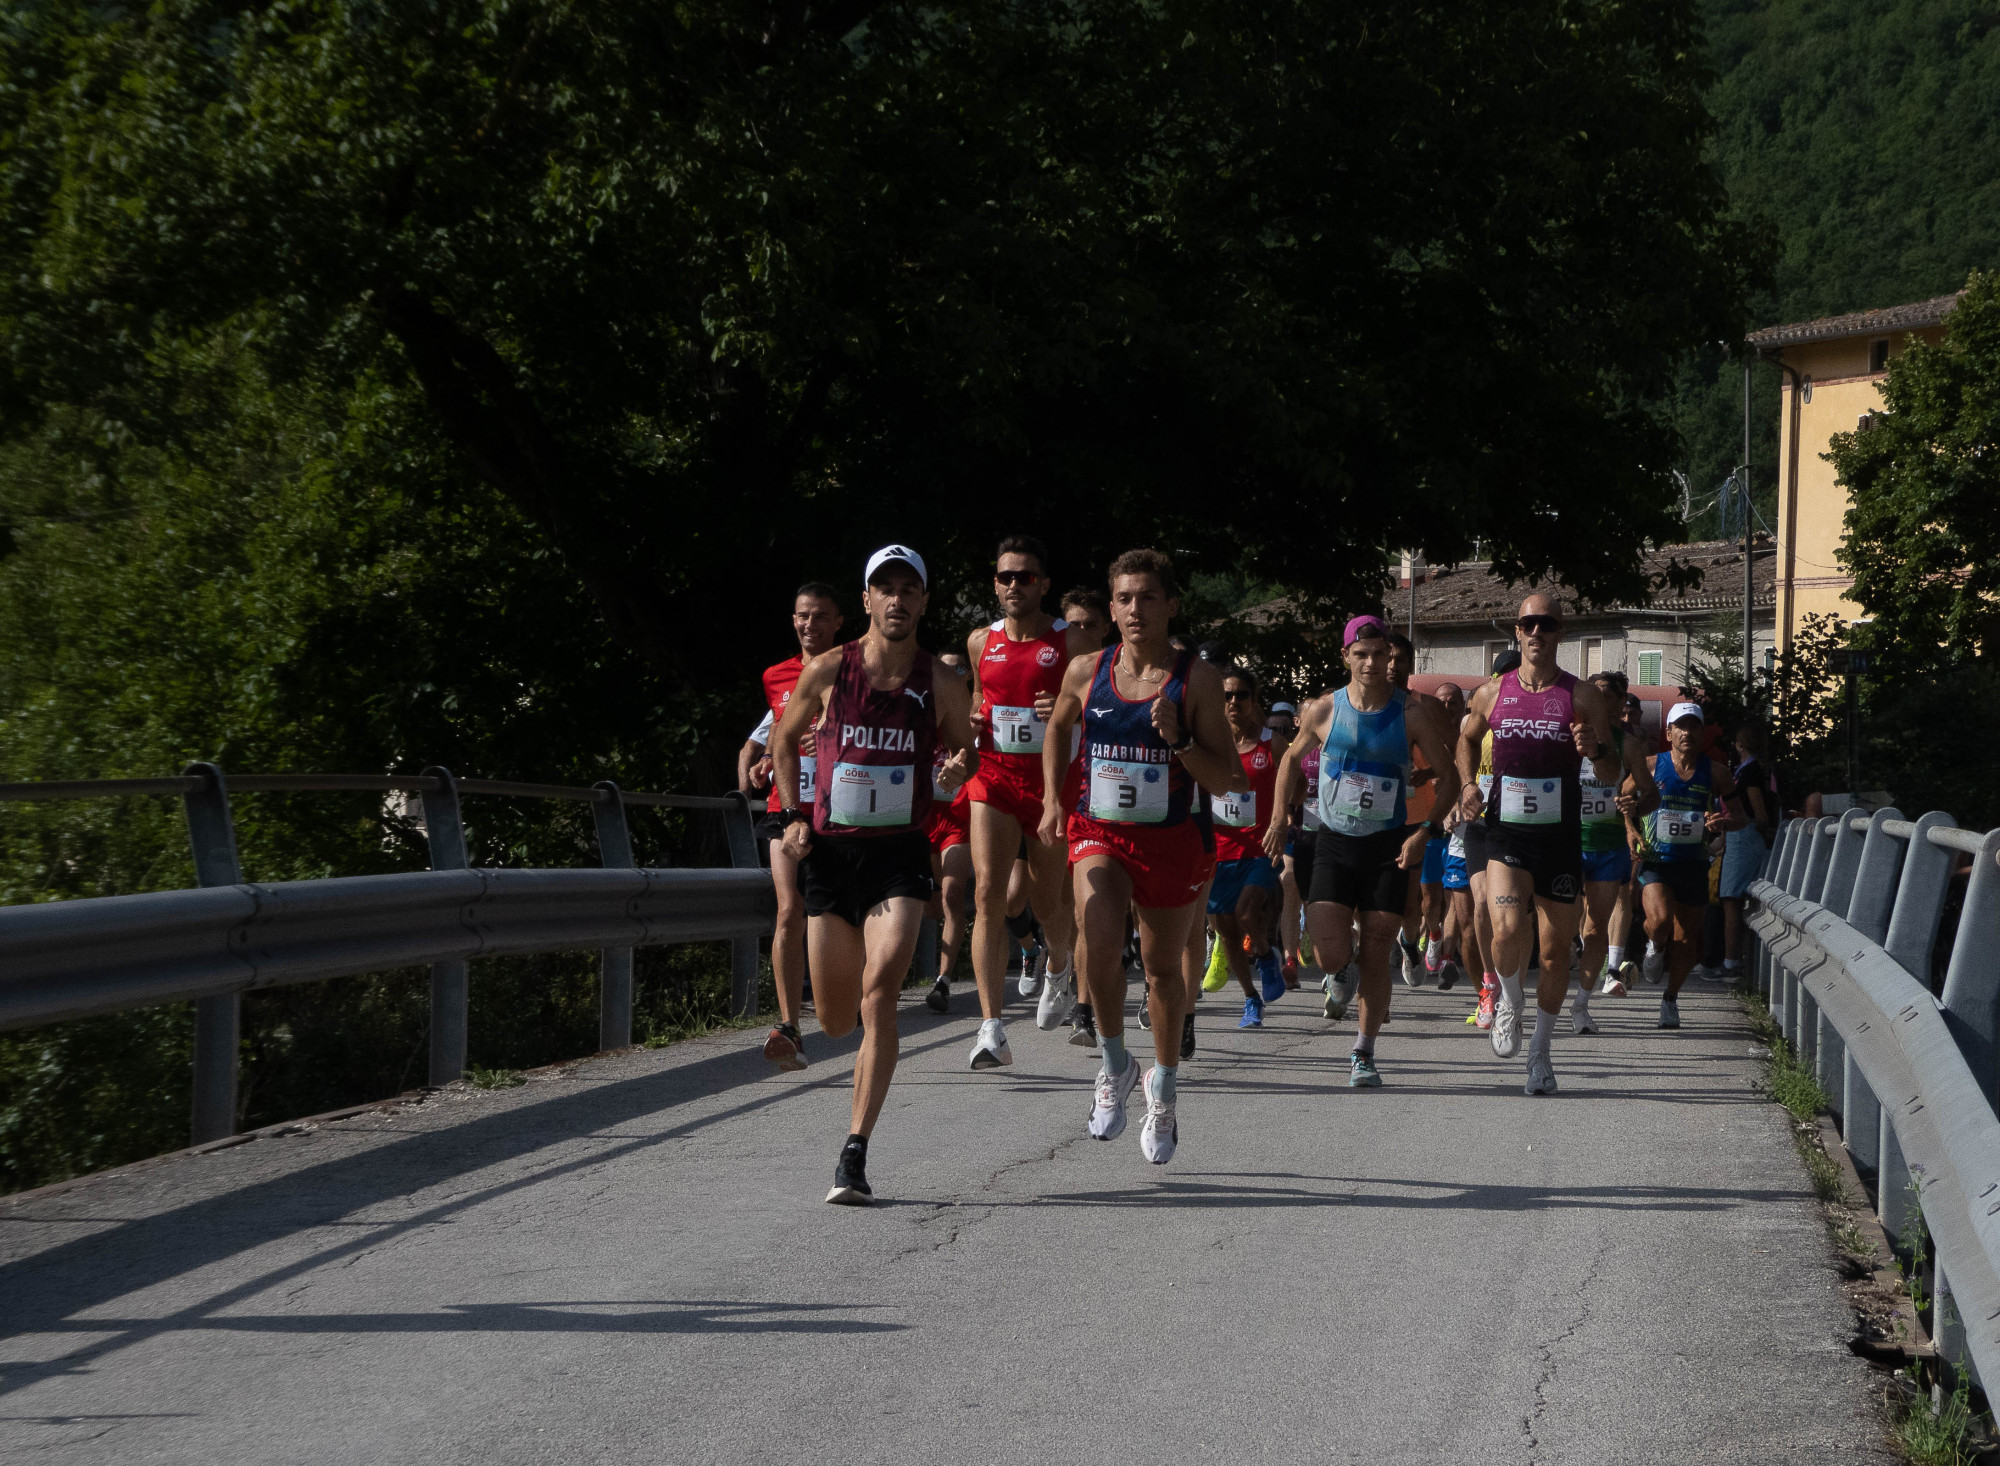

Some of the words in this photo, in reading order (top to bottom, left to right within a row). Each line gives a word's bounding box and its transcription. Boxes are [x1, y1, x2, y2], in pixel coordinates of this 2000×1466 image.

[1000, 709, 1019, 717] GÖBA
[1501, 718, 1560, 730] SPACE
[841, 724, 915, 752] POLIZIA
[1010, 724, 1032, 743] 16
[1091, 742, 1172, 762] CARABINIERI
[845, 767, 870, 779] GÖBA
[1101, 764, 1125, 775] GÖBA
[869, 789, 877, 813] 1
[1118, 784, 1137, 809] 3
[1359, 791, 1374, 810] 6
[1523, 796, 1538, 813] 5
[1224, 803, 1240, 819] 14
[1581, 800, 1606, 815] 20
[1668, 822, 1693, 837] 85
